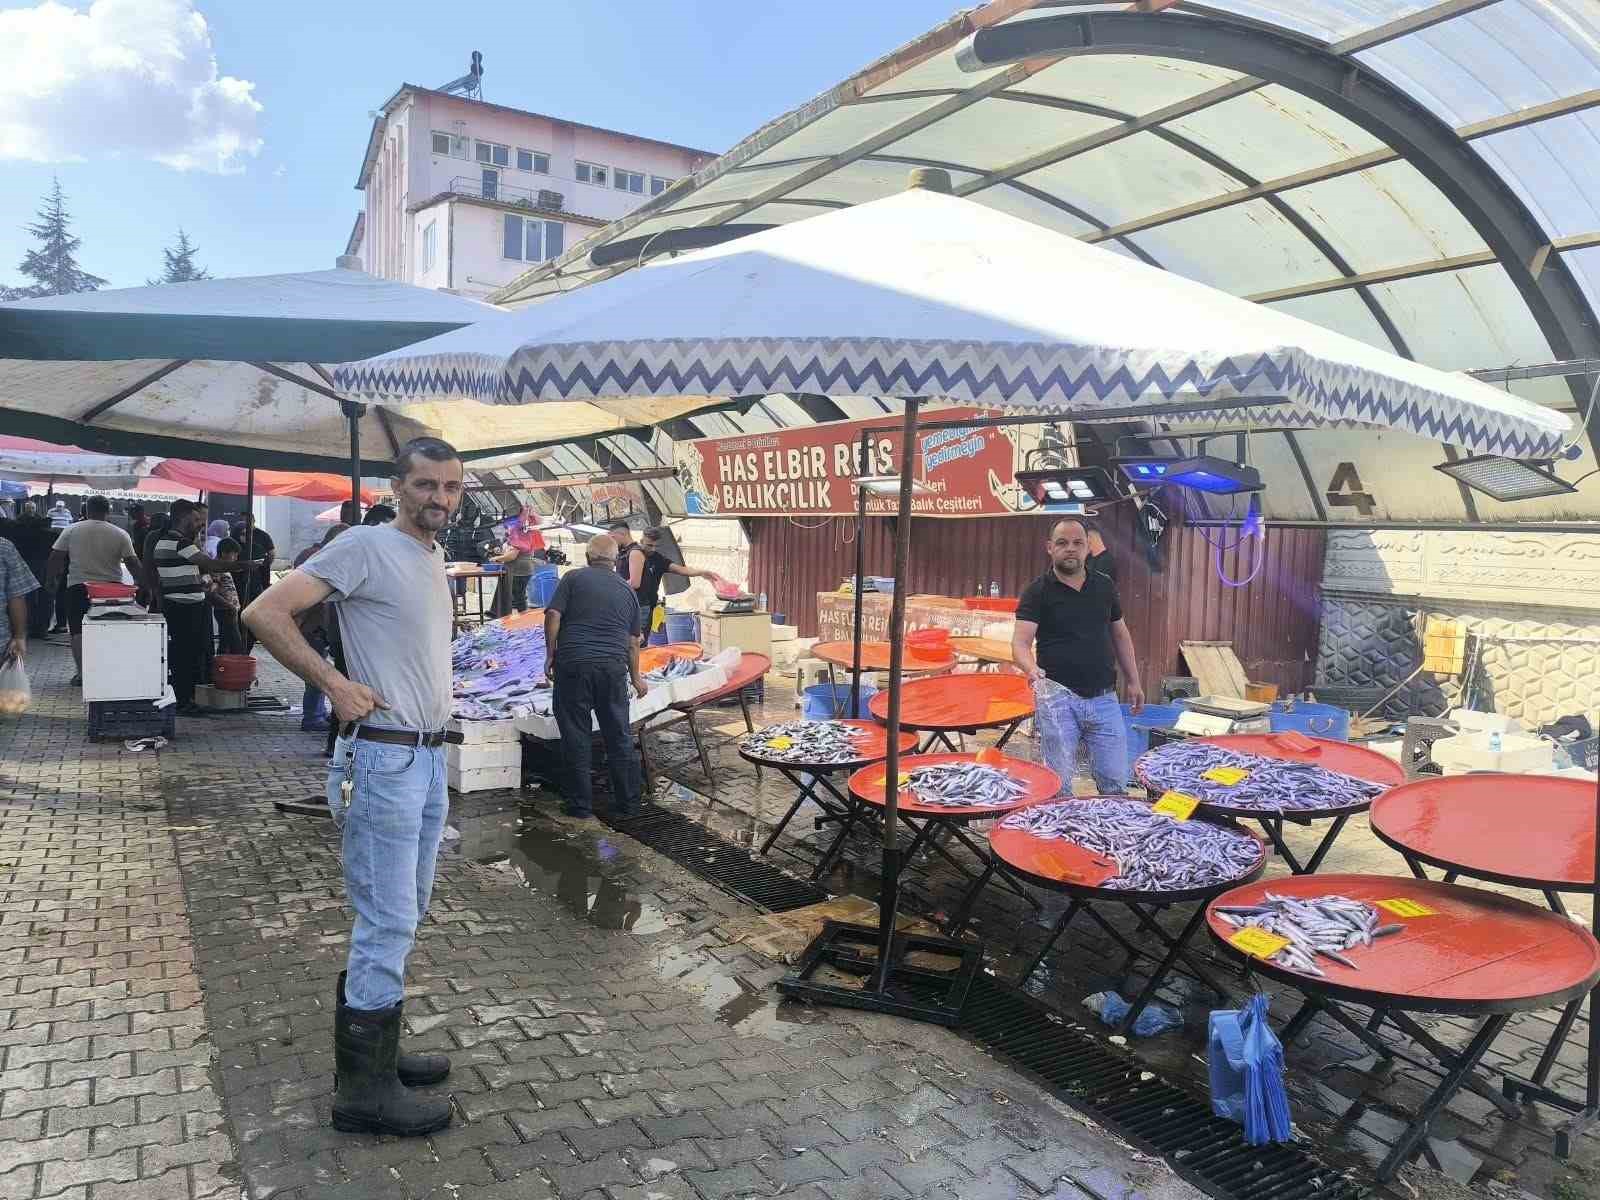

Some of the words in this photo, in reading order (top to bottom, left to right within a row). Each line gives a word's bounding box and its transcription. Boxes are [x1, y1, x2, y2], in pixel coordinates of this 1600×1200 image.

[718, 452, 759, 482] HAS
[722, 480, 832, 511] BALIKÇILIK
[936, 495, 983, 514] Çeşitleri
